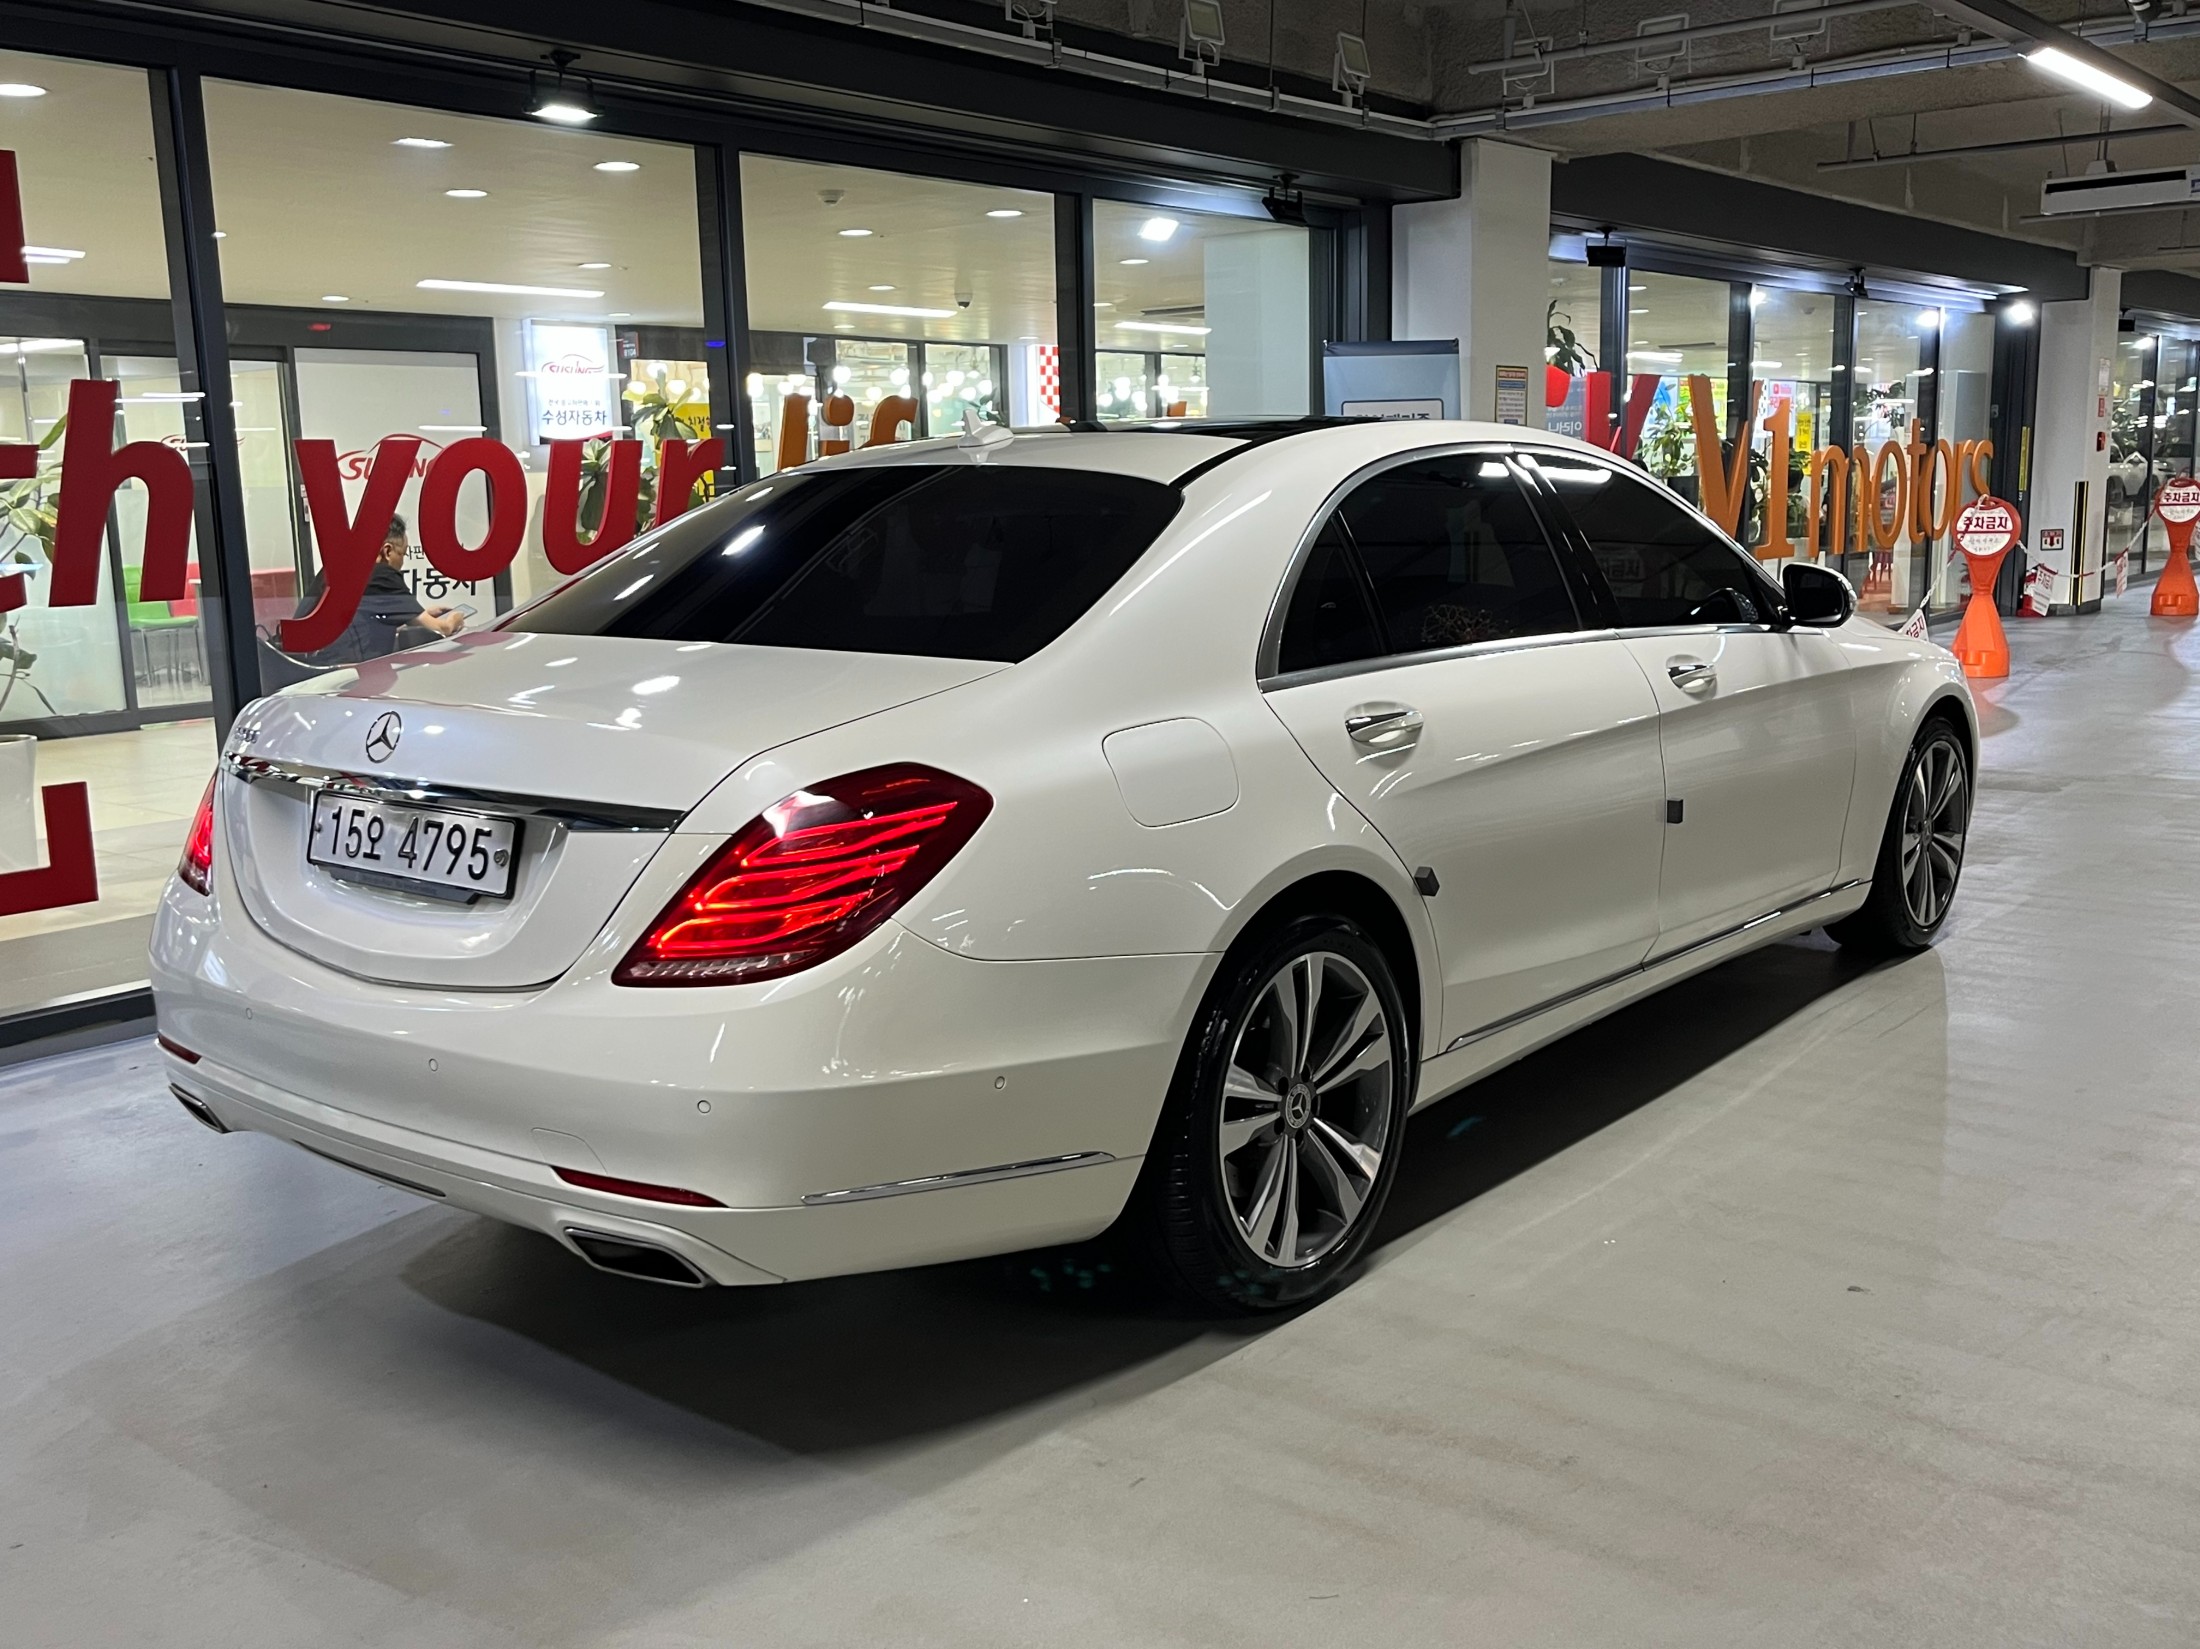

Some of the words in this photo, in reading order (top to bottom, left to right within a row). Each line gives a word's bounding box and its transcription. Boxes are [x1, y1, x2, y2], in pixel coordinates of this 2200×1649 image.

[541, 409, 608, 426] 수성자동차
[2163, 491, 2200, 503] 주차금지
[1963, 516, 2008, 530] 주차금지
[280, 437, 725, 653] your
[331, 805, 385, 861] 15오
[397, 816, 493, 881] 4795
